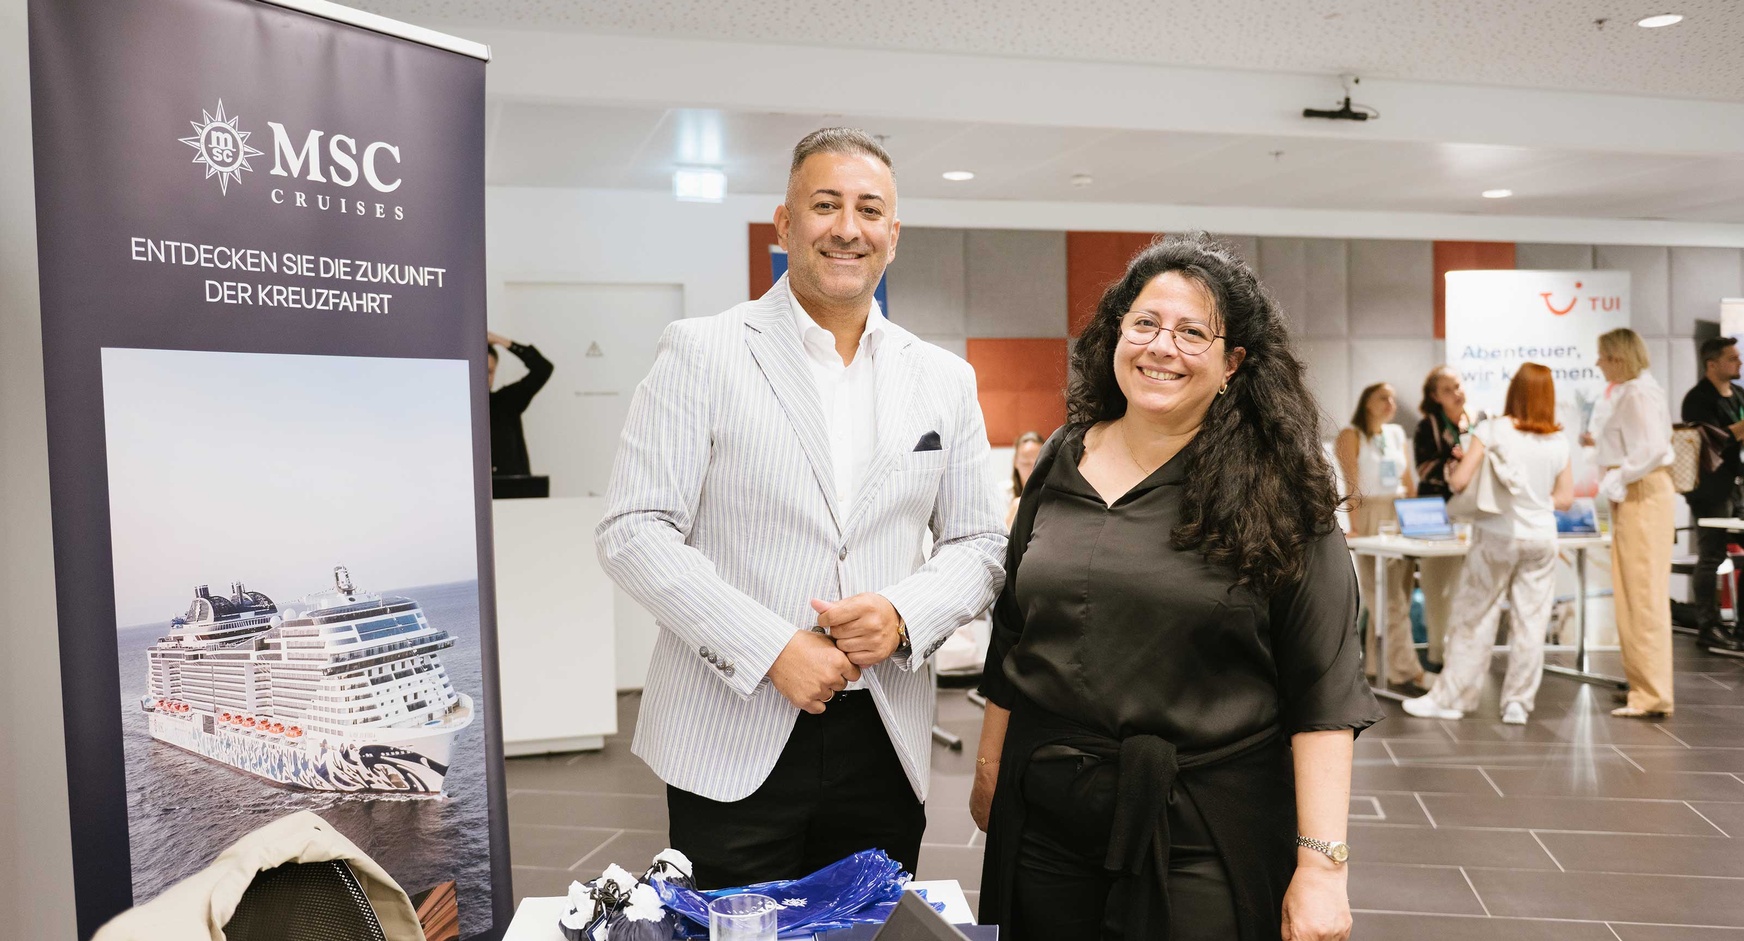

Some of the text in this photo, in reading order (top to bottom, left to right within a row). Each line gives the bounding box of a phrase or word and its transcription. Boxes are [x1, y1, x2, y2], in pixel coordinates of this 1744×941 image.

[267, 121, 402, 193] MSC
[271, 188, 404, 221] CRUISES
[131, 237, 446, 288] ENTDECKEN SIE DIE ZUKUNFT
[205, 279, 393, 314] DER KREUZFAHRT
[1588, 296, 1621, 312] TUI
[1461, 345, 1582, 360] Abenteuer,
[1502, 366, 1601, 381] kmen.
